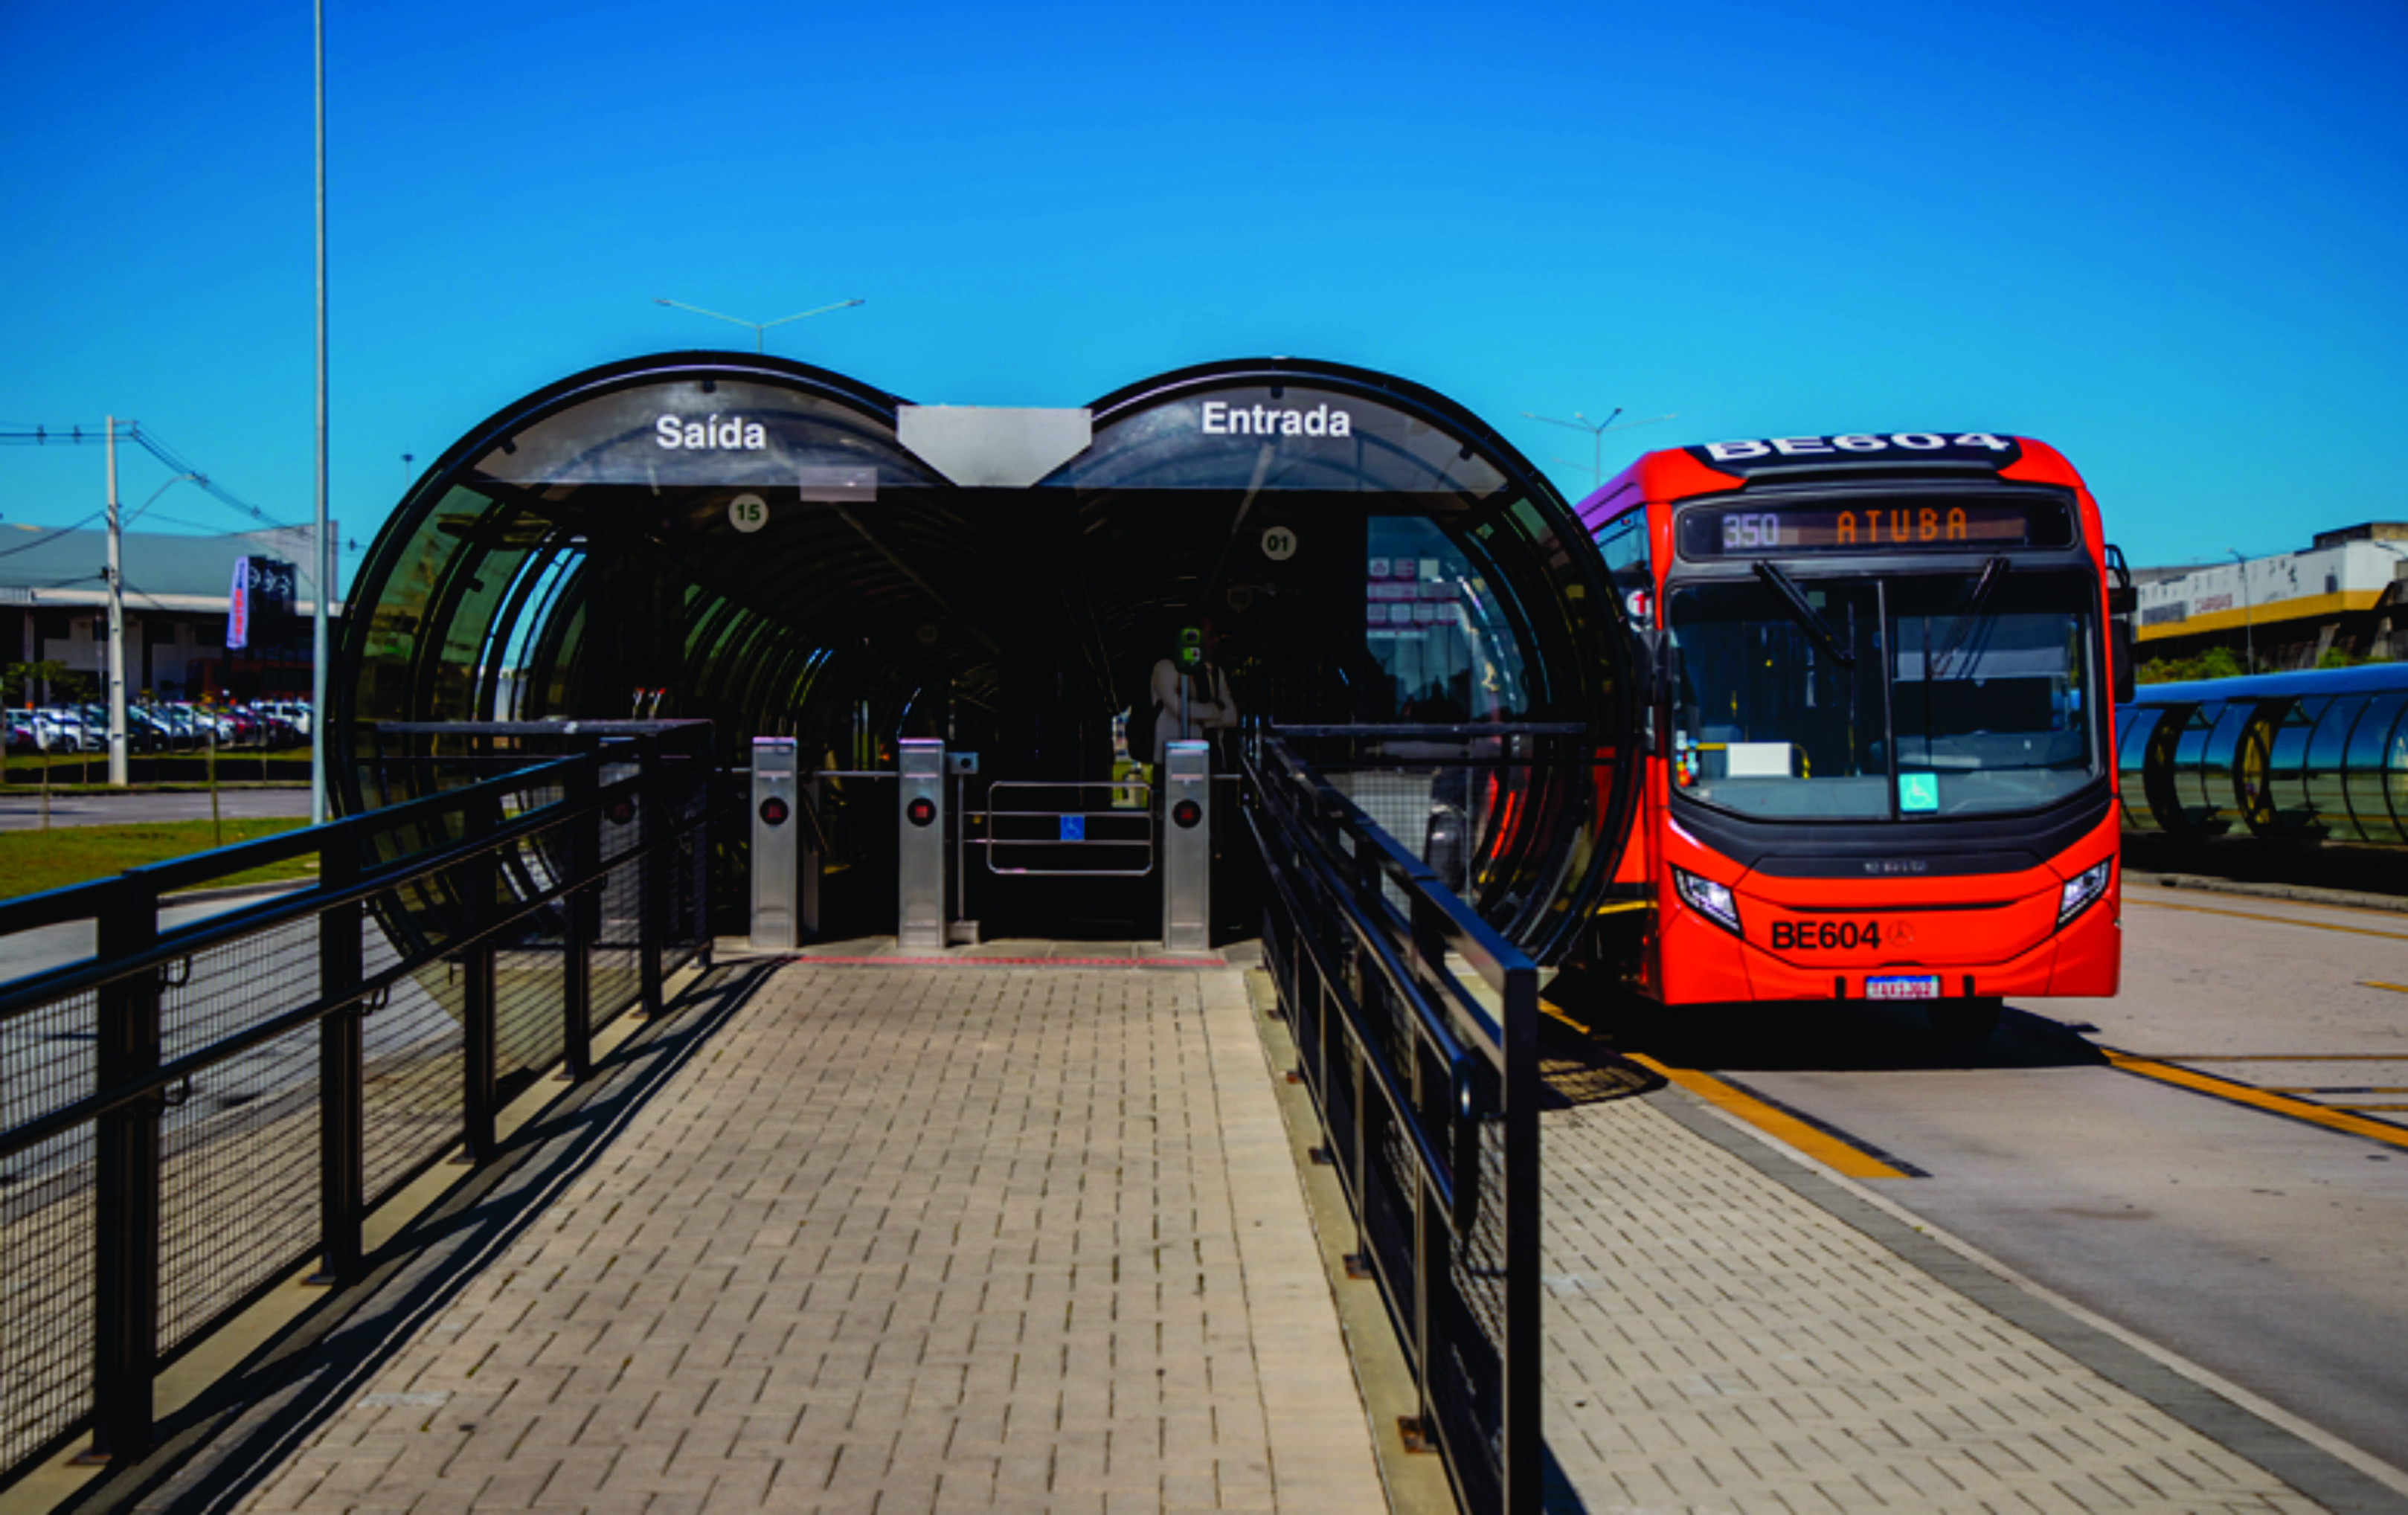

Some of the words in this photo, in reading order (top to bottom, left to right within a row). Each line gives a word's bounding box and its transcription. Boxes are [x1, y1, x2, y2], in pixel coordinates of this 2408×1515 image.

[656, 413, 767, 449] Saída
[1202, 402, 1351, 437] Entrada
[1705, 433, 2010, 461] BE604
[736, 504, 760, 522] 15
[1723, 514, 1780, 549] 350
[1837, 508, 1966, 544] ATUBA
[1267, 535, 1288, 552] 01
[1772, 921, 1881, 949] BE604
